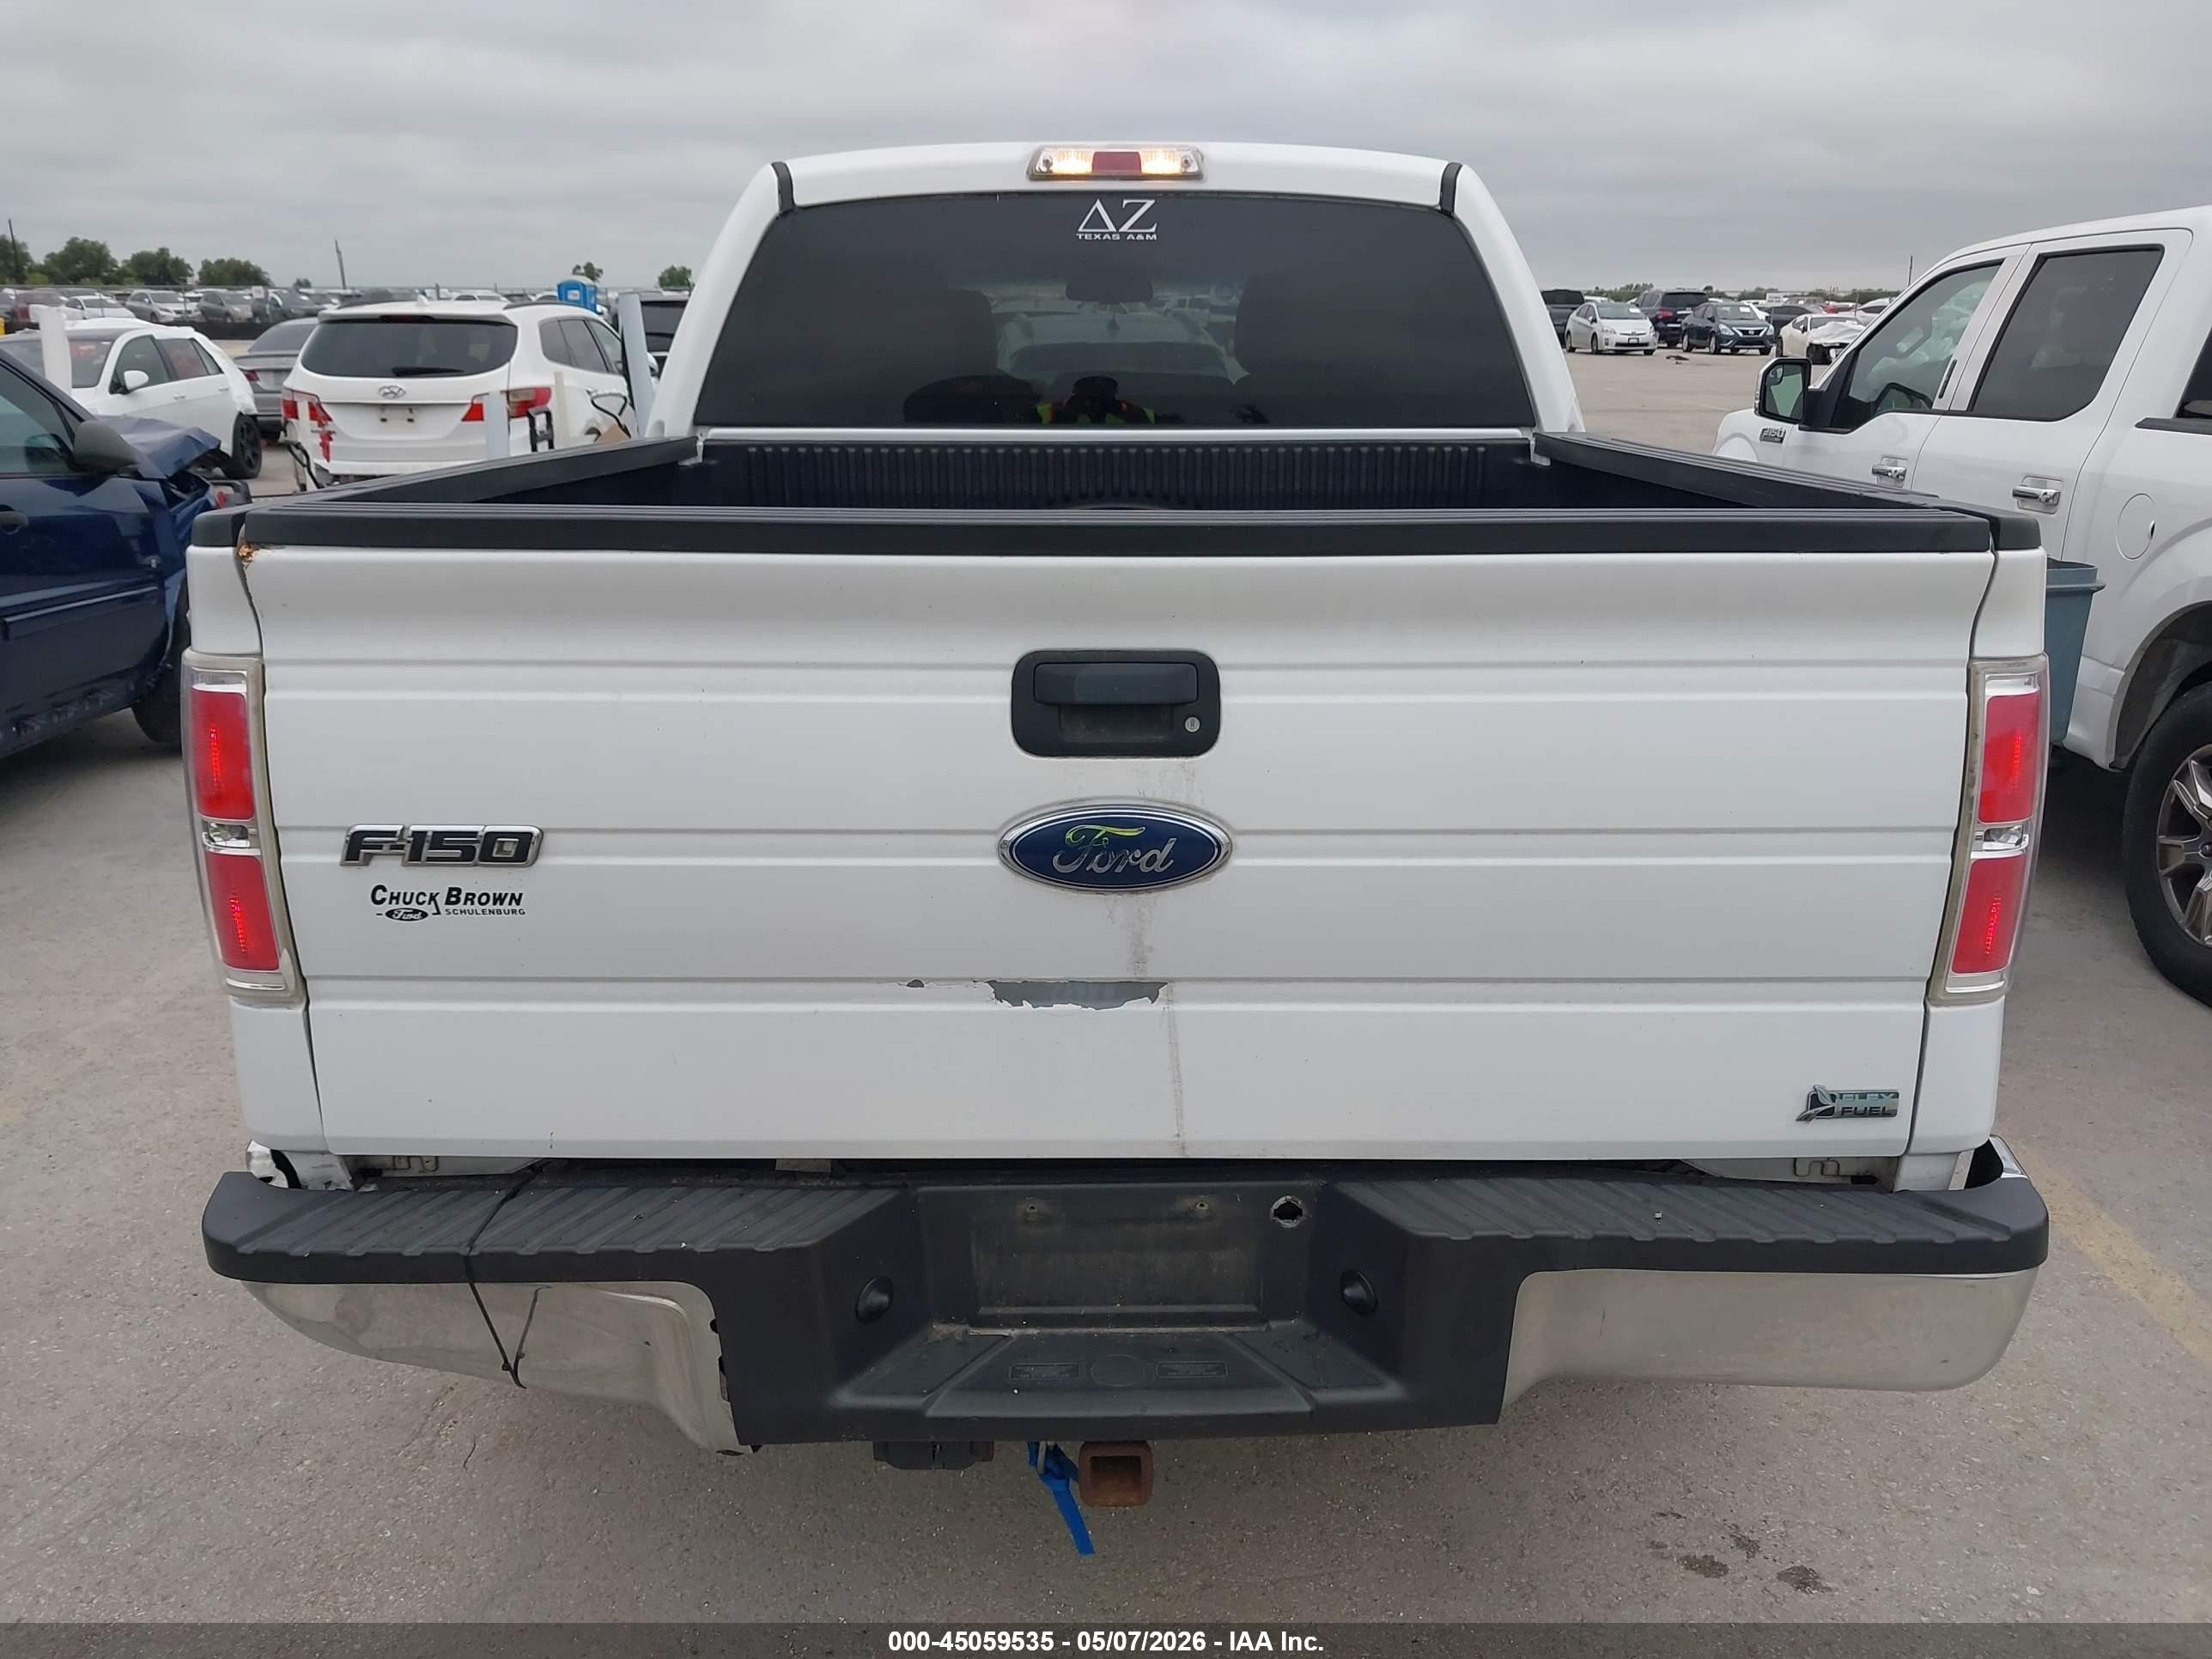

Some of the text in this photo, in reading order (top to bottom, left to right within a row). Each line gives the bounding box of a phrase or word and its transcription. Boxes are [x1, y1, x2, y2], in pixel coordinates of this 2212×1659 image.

[339, 824, 544, 867] F-150
[1052, 824, 1177, 873] Ford
[370, 884, 524, 915] CHUCK BROWN
[391, 908, 423, 921] Ford
[445, 908, 526, 916] SCHULENBURG
[1840, 1106, 1892, 1116] FUEL
